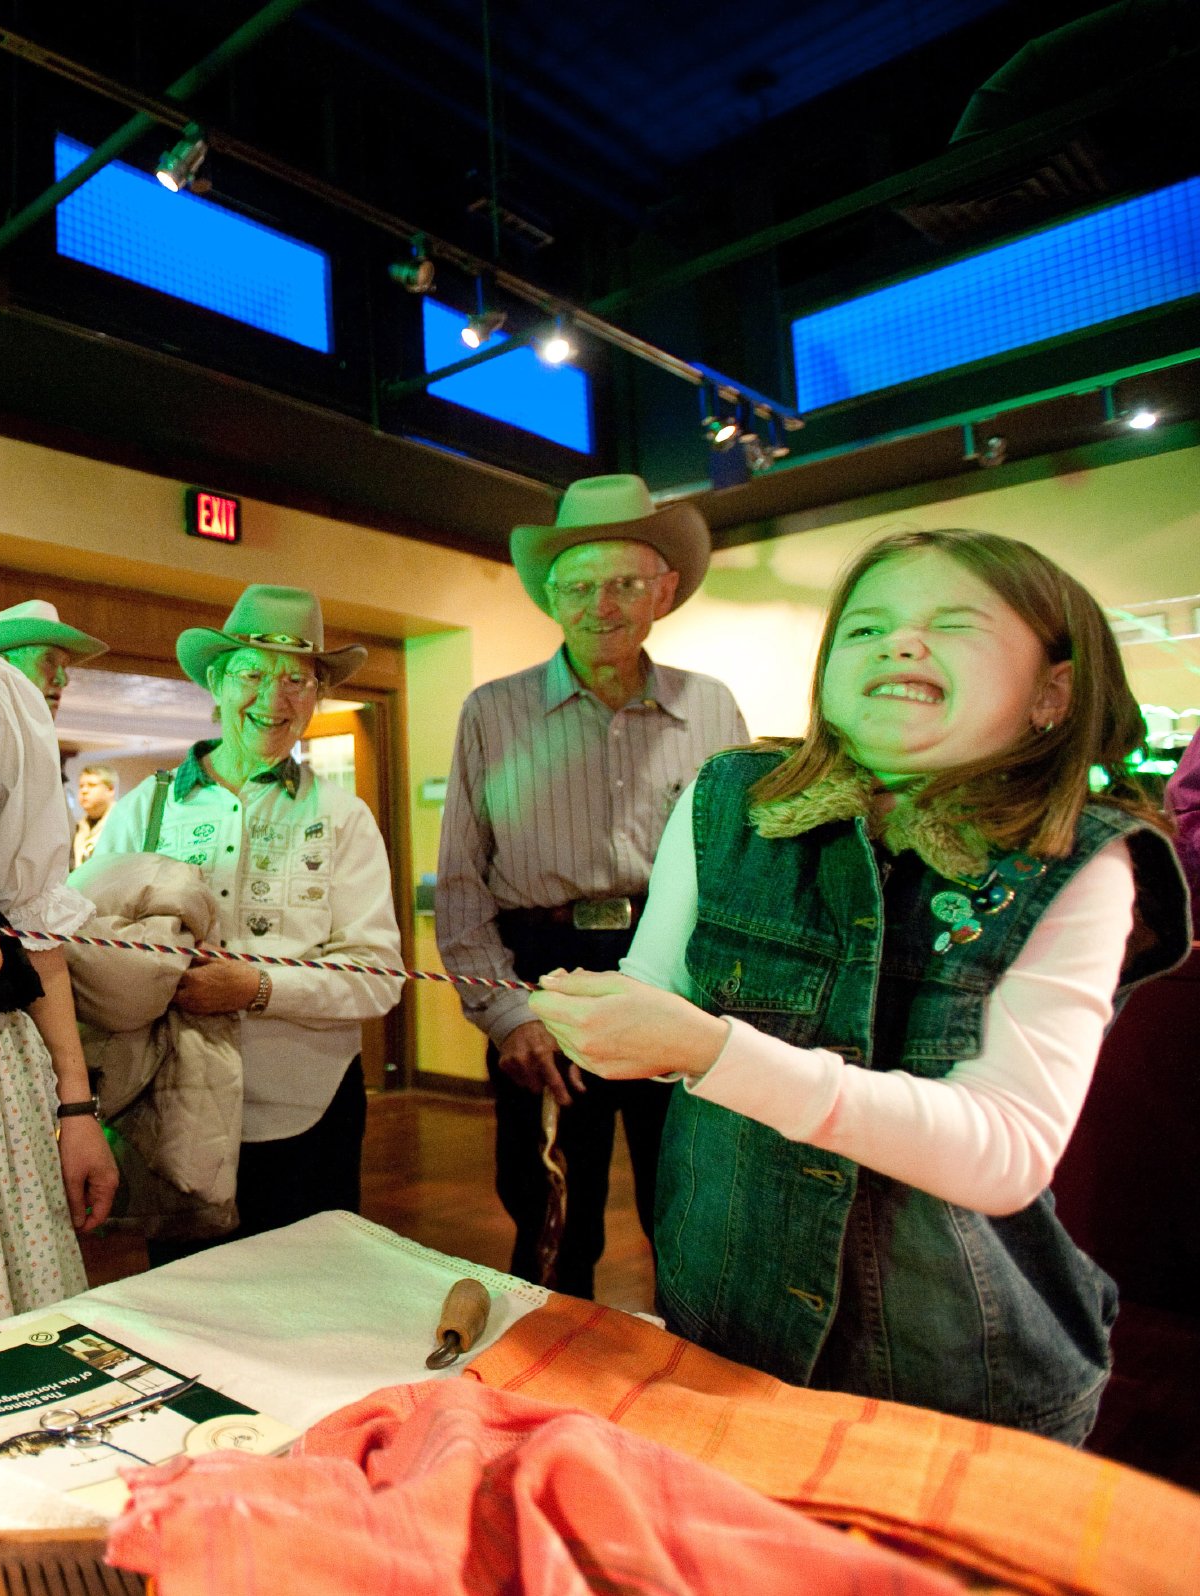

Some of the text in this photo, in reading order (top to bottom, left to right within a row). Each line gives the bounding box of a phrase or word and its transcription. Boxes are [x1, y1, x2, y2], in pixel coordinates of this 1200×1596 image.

[197, 492, 237, 541] EXIT
[79, 1371, 93, 1380] of
[60, 1377, 80, 1386] the
[40, 1391, 66, 1401] The
